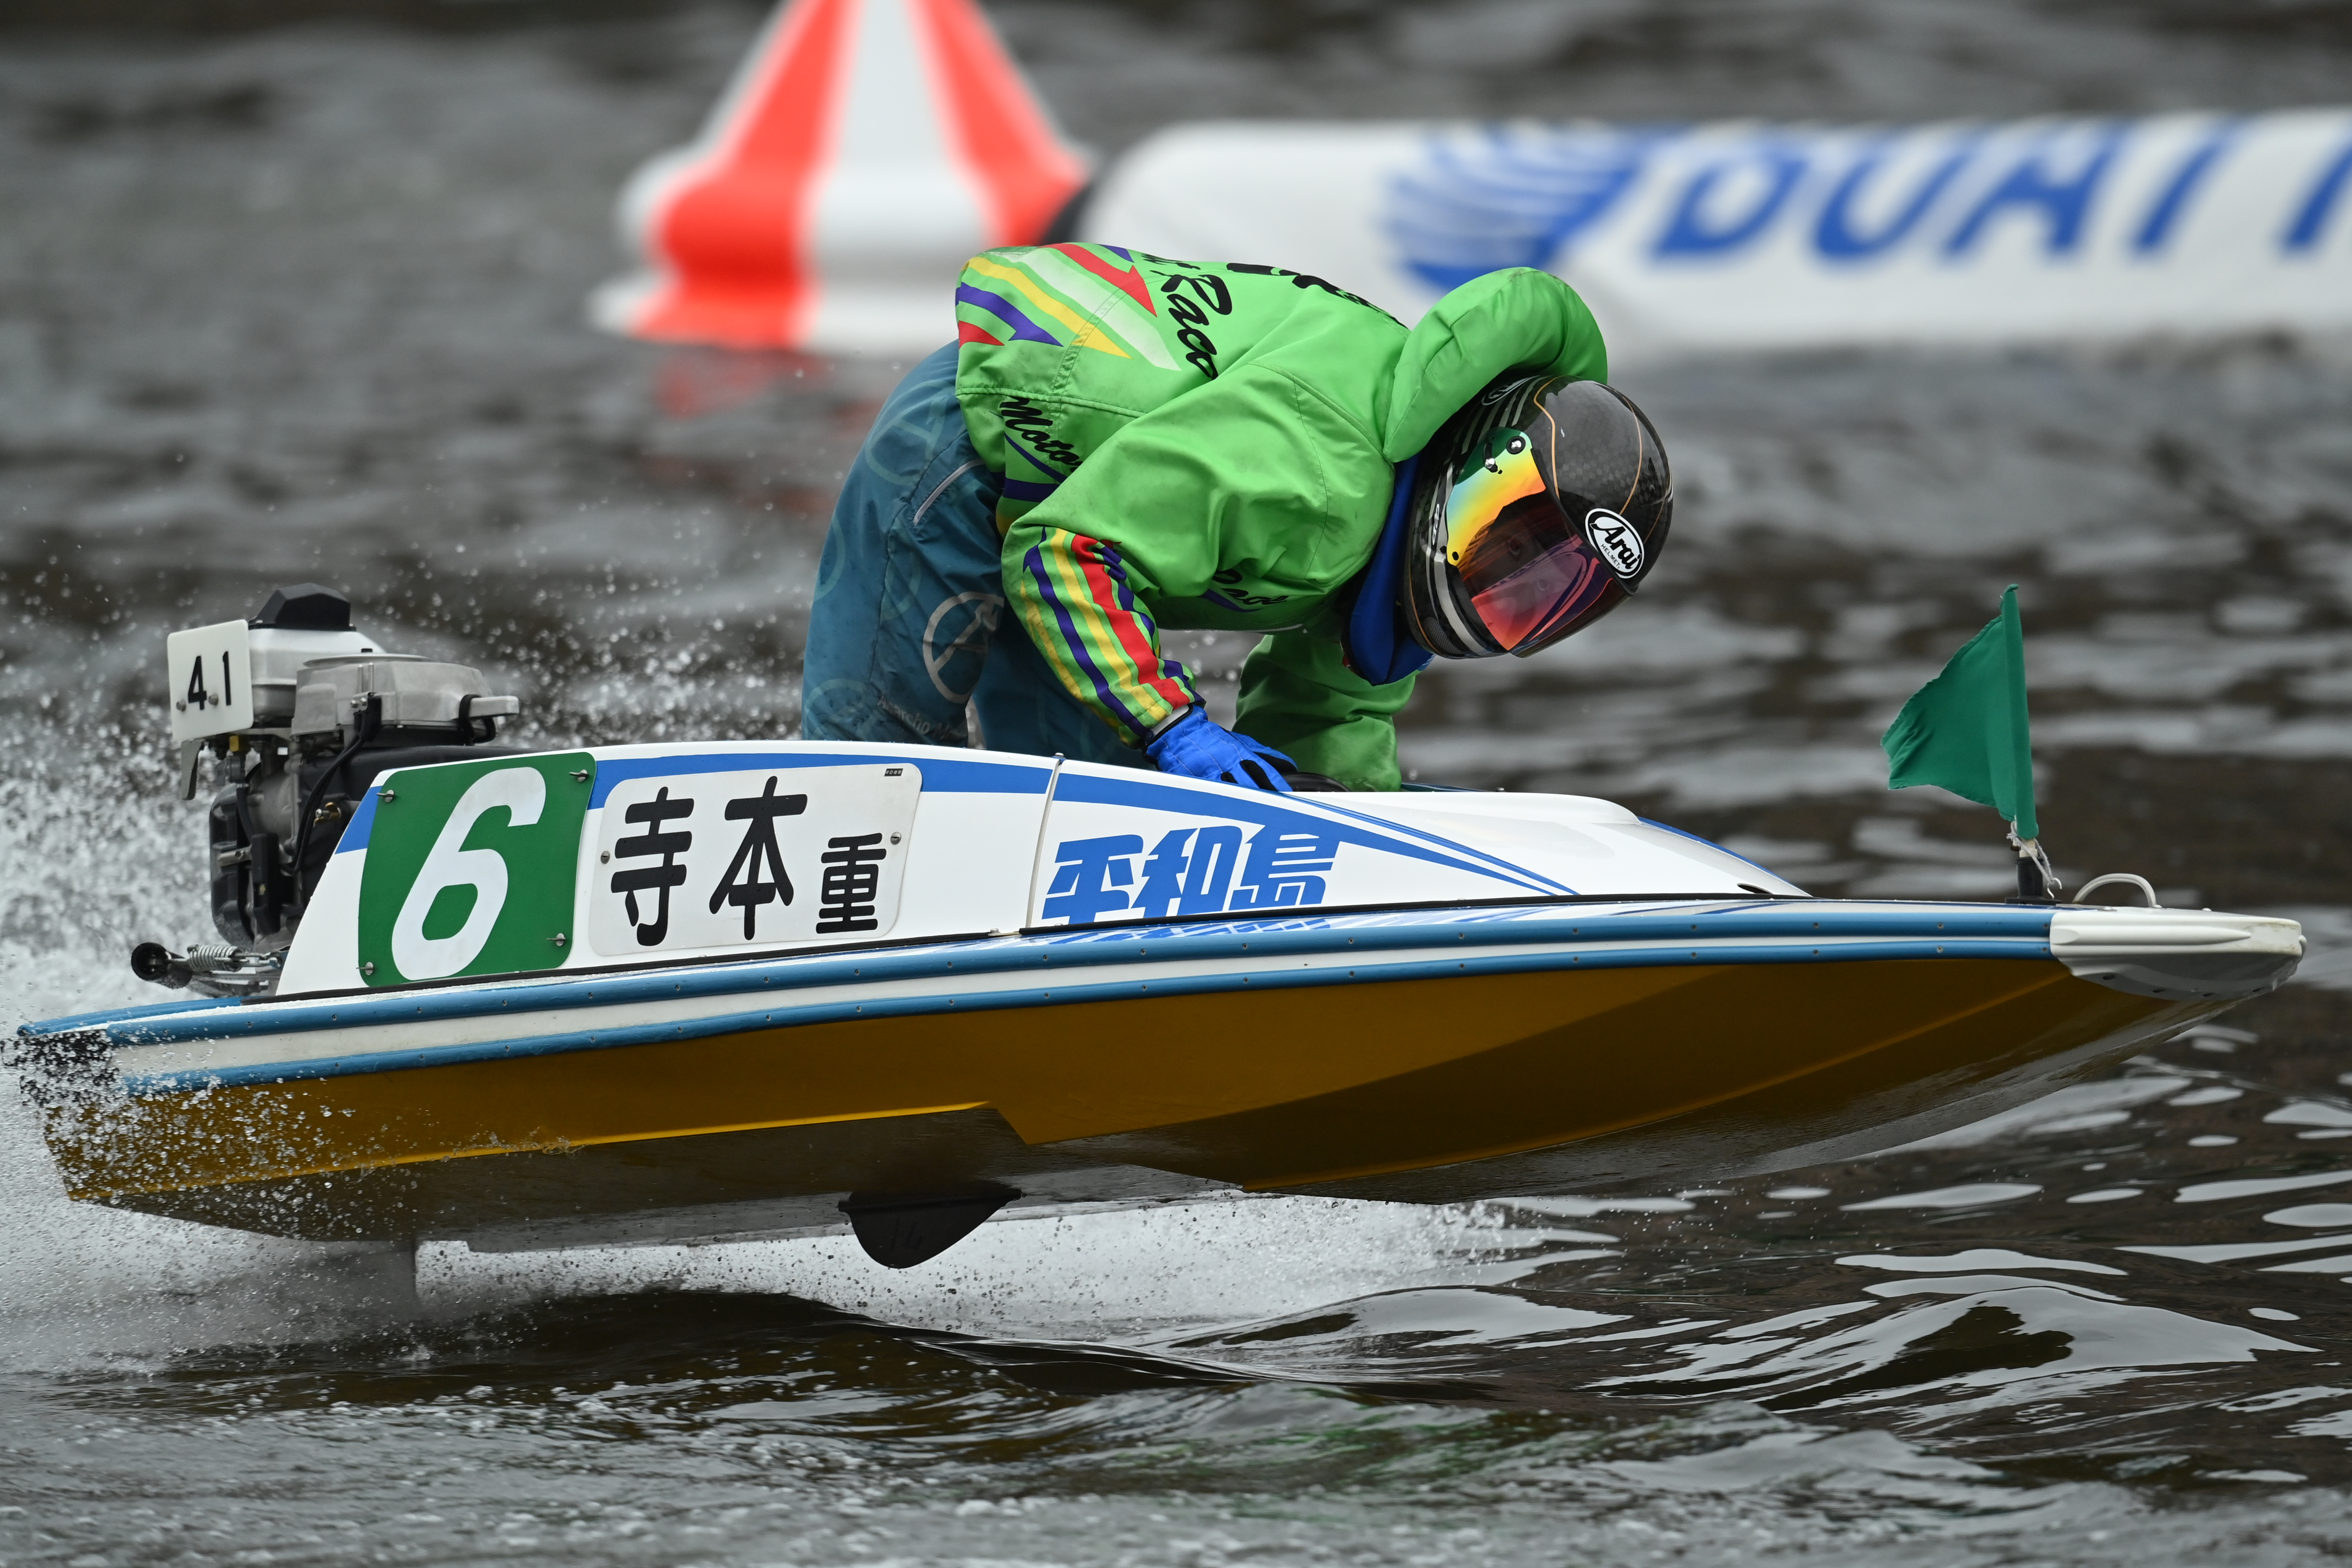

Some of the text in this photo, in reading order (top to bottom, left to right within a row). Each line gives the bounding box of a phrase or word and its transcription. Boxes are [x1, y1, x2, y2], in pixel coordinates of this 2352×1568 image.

[999, 396, 1083, 472] Moto
[1590, 523, 1642, 569] Arai
[1601, 543, 1620, 567] HELMET
[188, 651, 231, 710] 41
[392, 767, 546, 980] 6
[1042, 825, 1340, 925] 平和島
